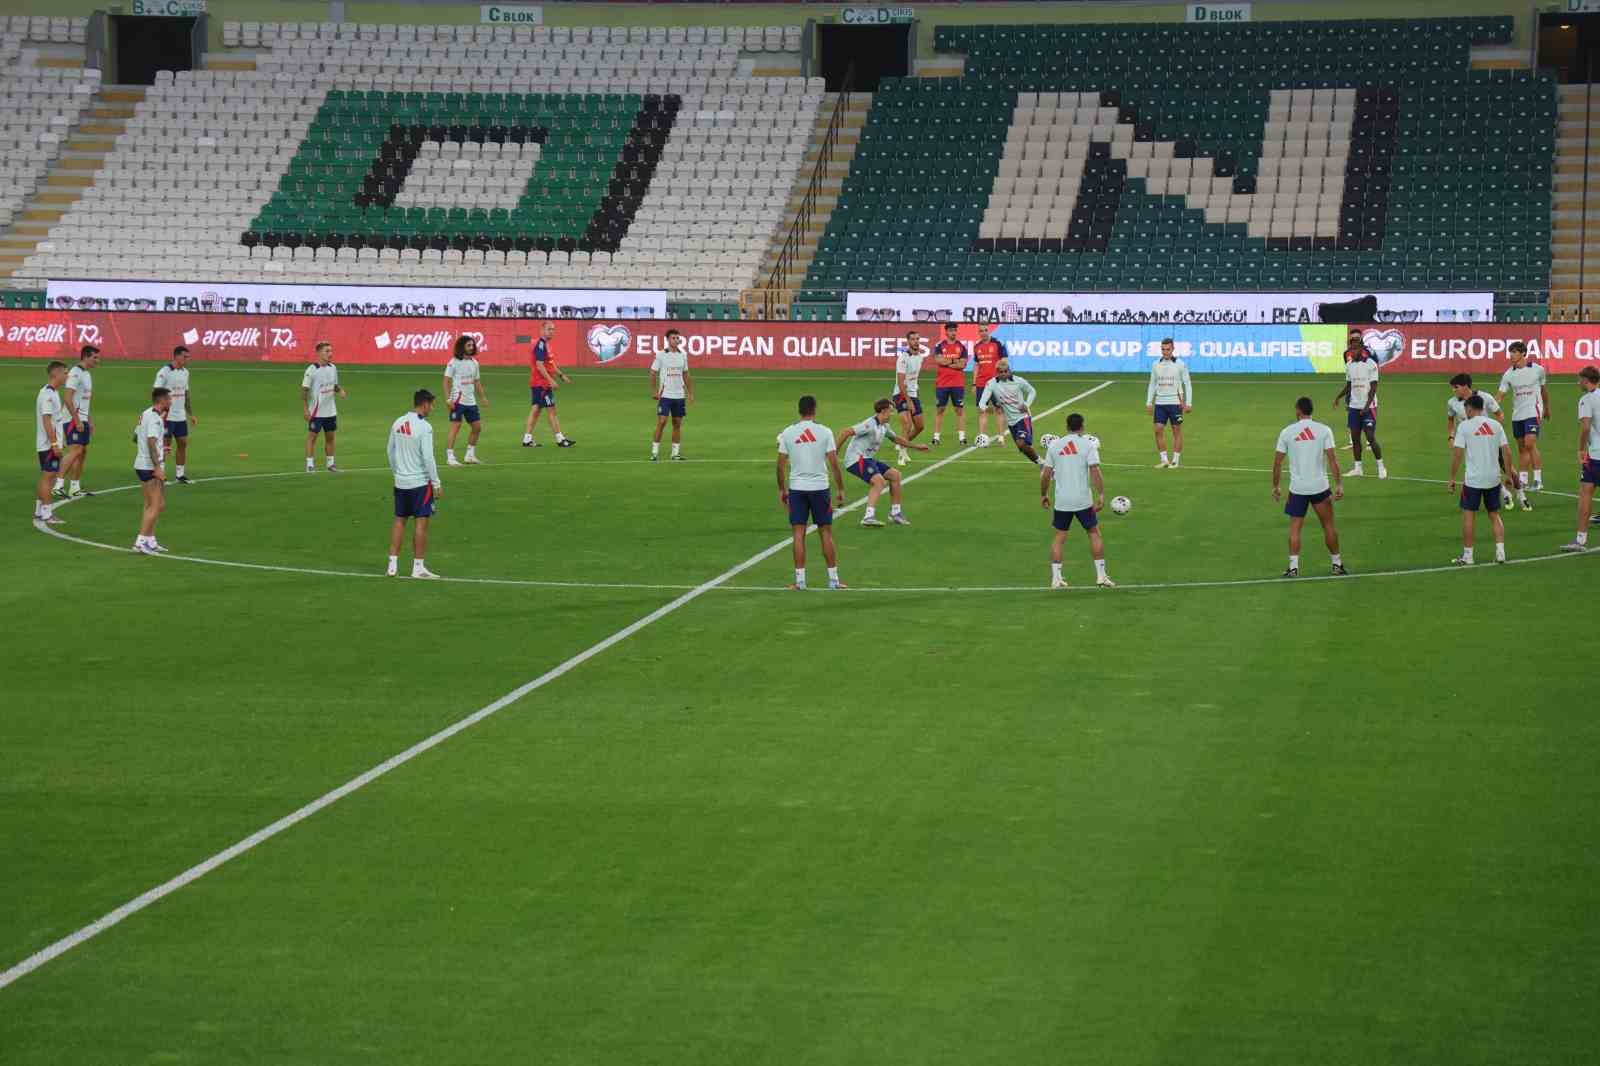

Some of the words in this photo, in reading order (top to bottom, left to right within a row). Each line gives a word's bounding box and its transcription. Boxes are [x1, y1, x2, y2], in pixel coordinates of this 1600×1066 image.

[503, 12, 534, 22] BLOK
[1210, 9, 1242, 21] BLOK
[7, 324, 66, 346] arçelik
[202, 328, 261, 350] arçelik
[393, 331, 452, 354] arçelik
[1006, 340, 1092, 357] WORLD
[1095, 340, 1142, 357] CUP
[1199, 341, 1333, 358] QUALIFIERS
[1411, 338, 1564, 360] EUROPEAN
